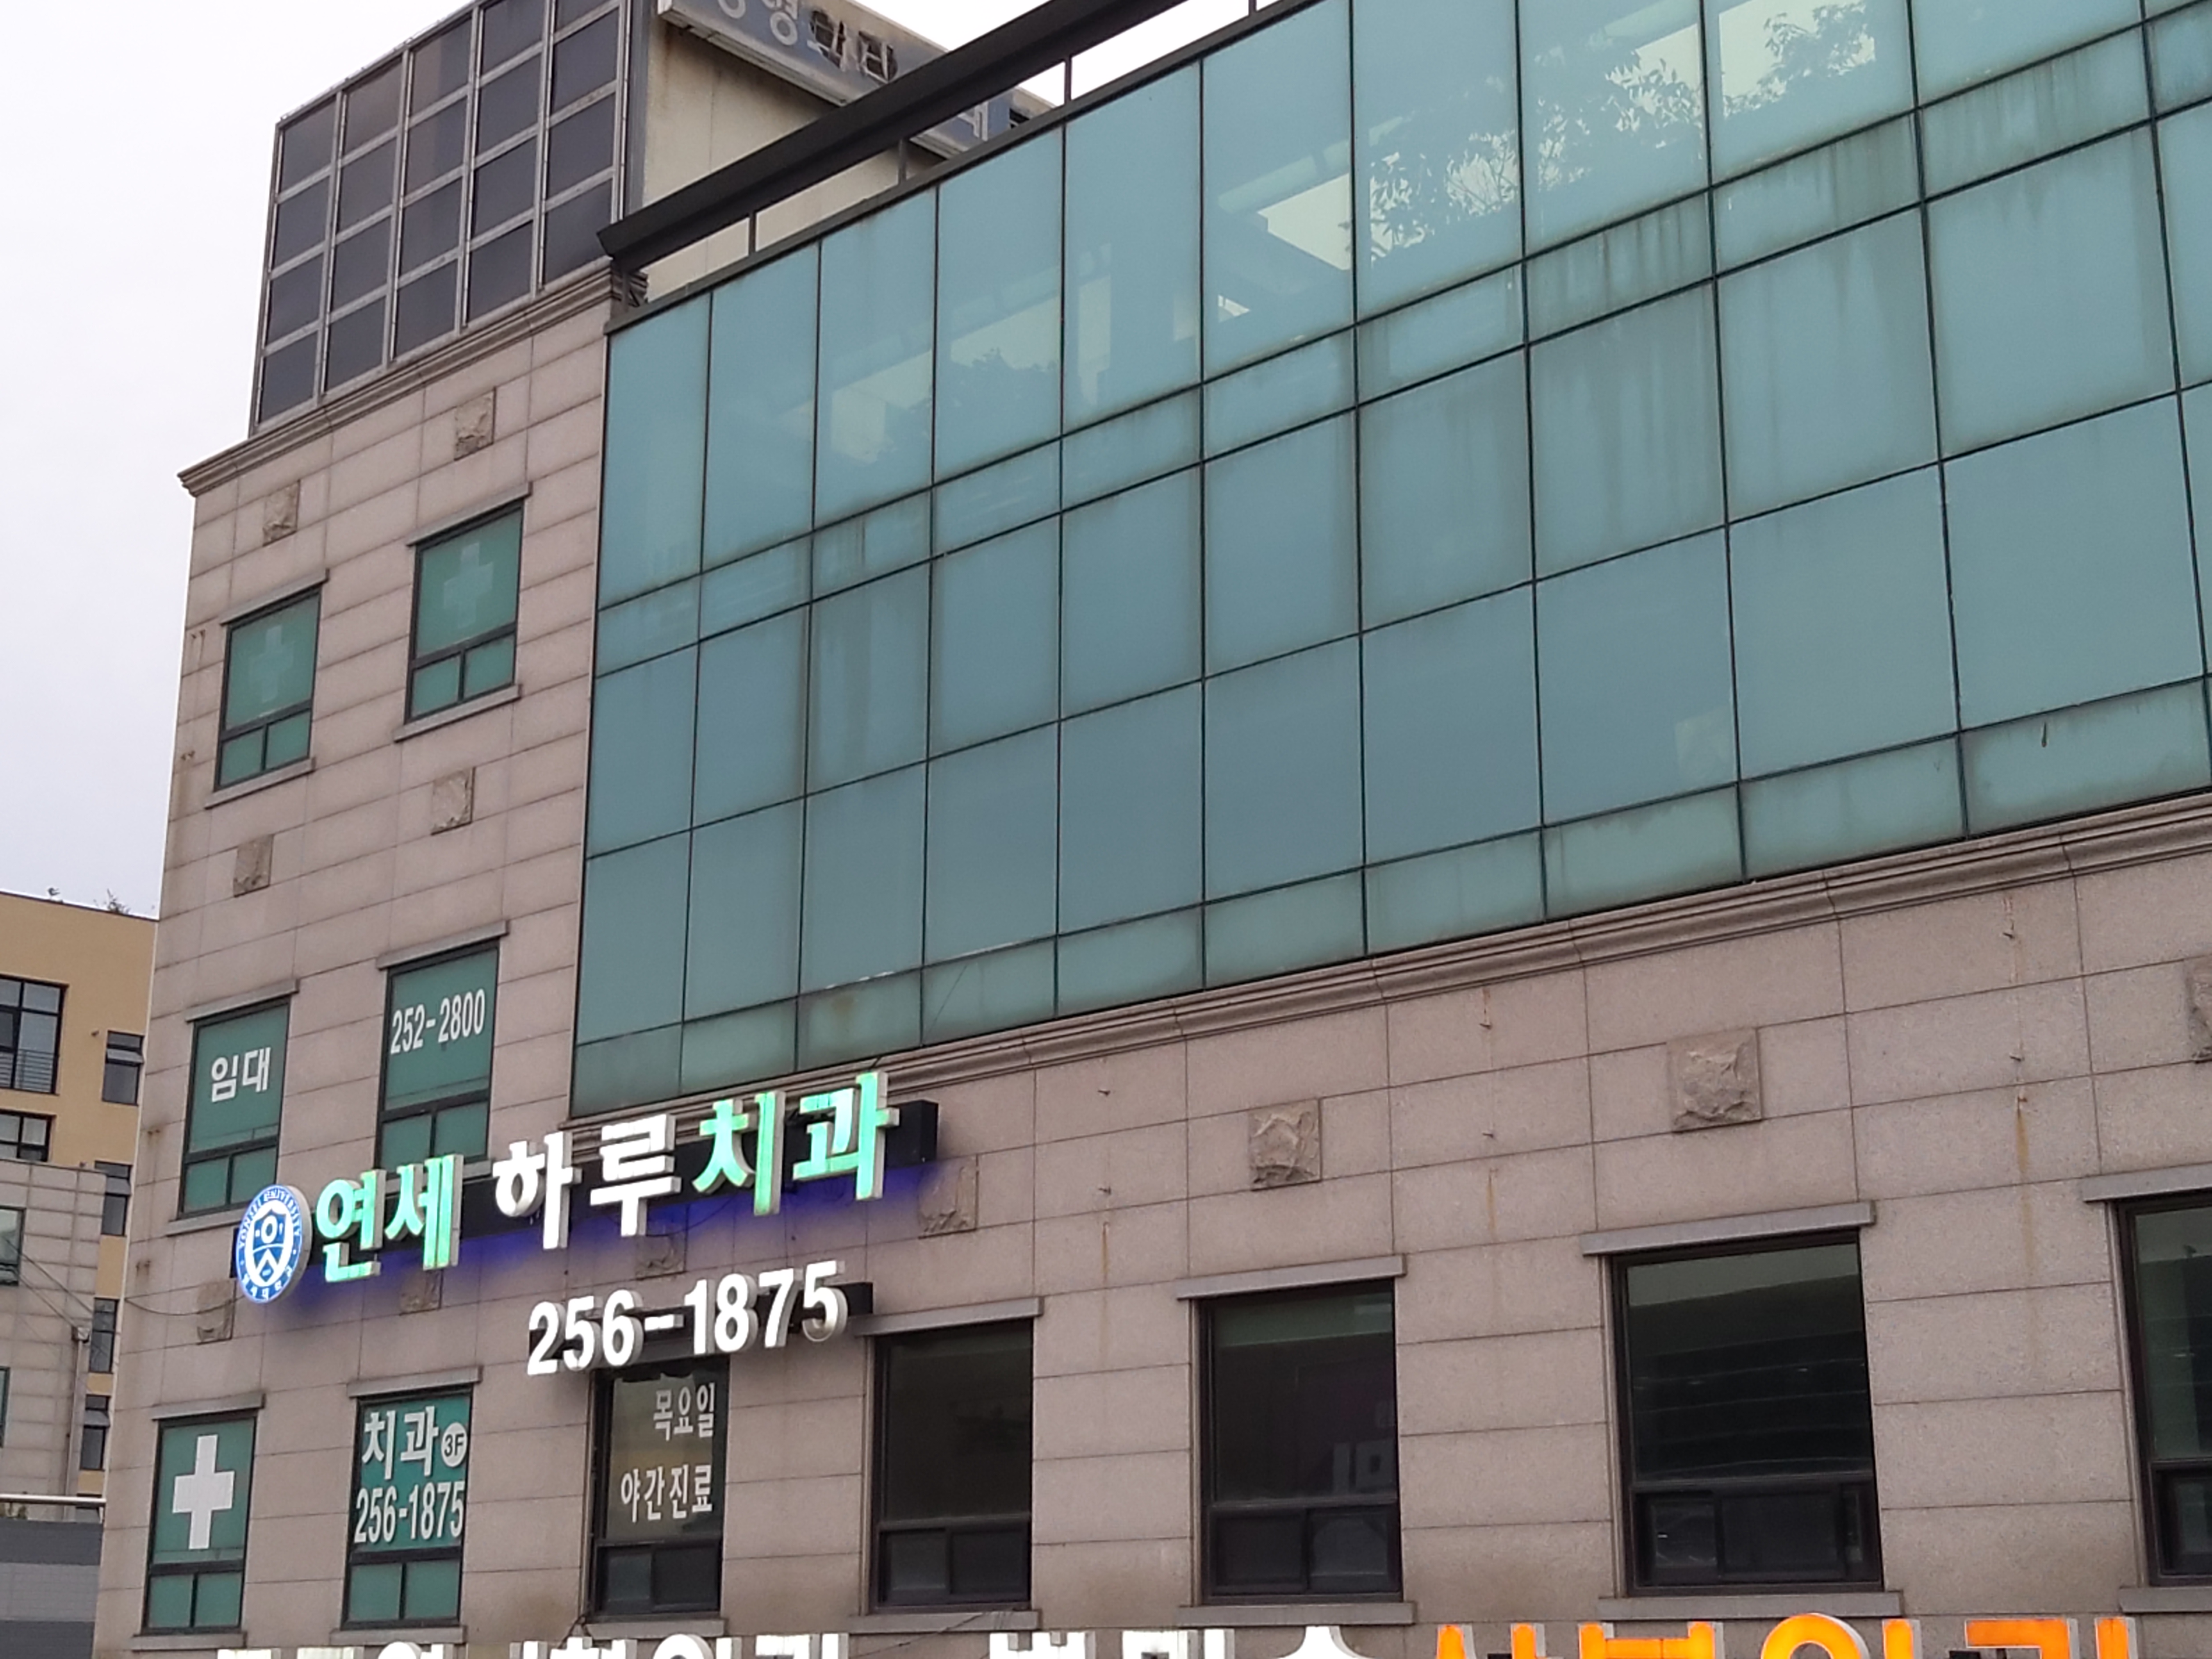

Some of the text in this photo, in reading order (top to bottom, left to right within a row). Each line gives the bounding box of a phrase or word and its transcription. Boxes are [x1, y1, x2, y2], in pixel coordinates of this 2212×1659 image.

[391, 988, 485, 1054] 252-2800
[211, 1047, 271, 1102] 임대
[316, 1154, 461, 1282] 연세
[526, 1260, 847, 1375] 256-1875
[362, 1406, 465, 1480] 치과 3F
[653, 1383, 714, 1441] 목요일
[354, 1481, 466, 1543] 256-1875
[621, 1464, 713, 1523] 야간진료
